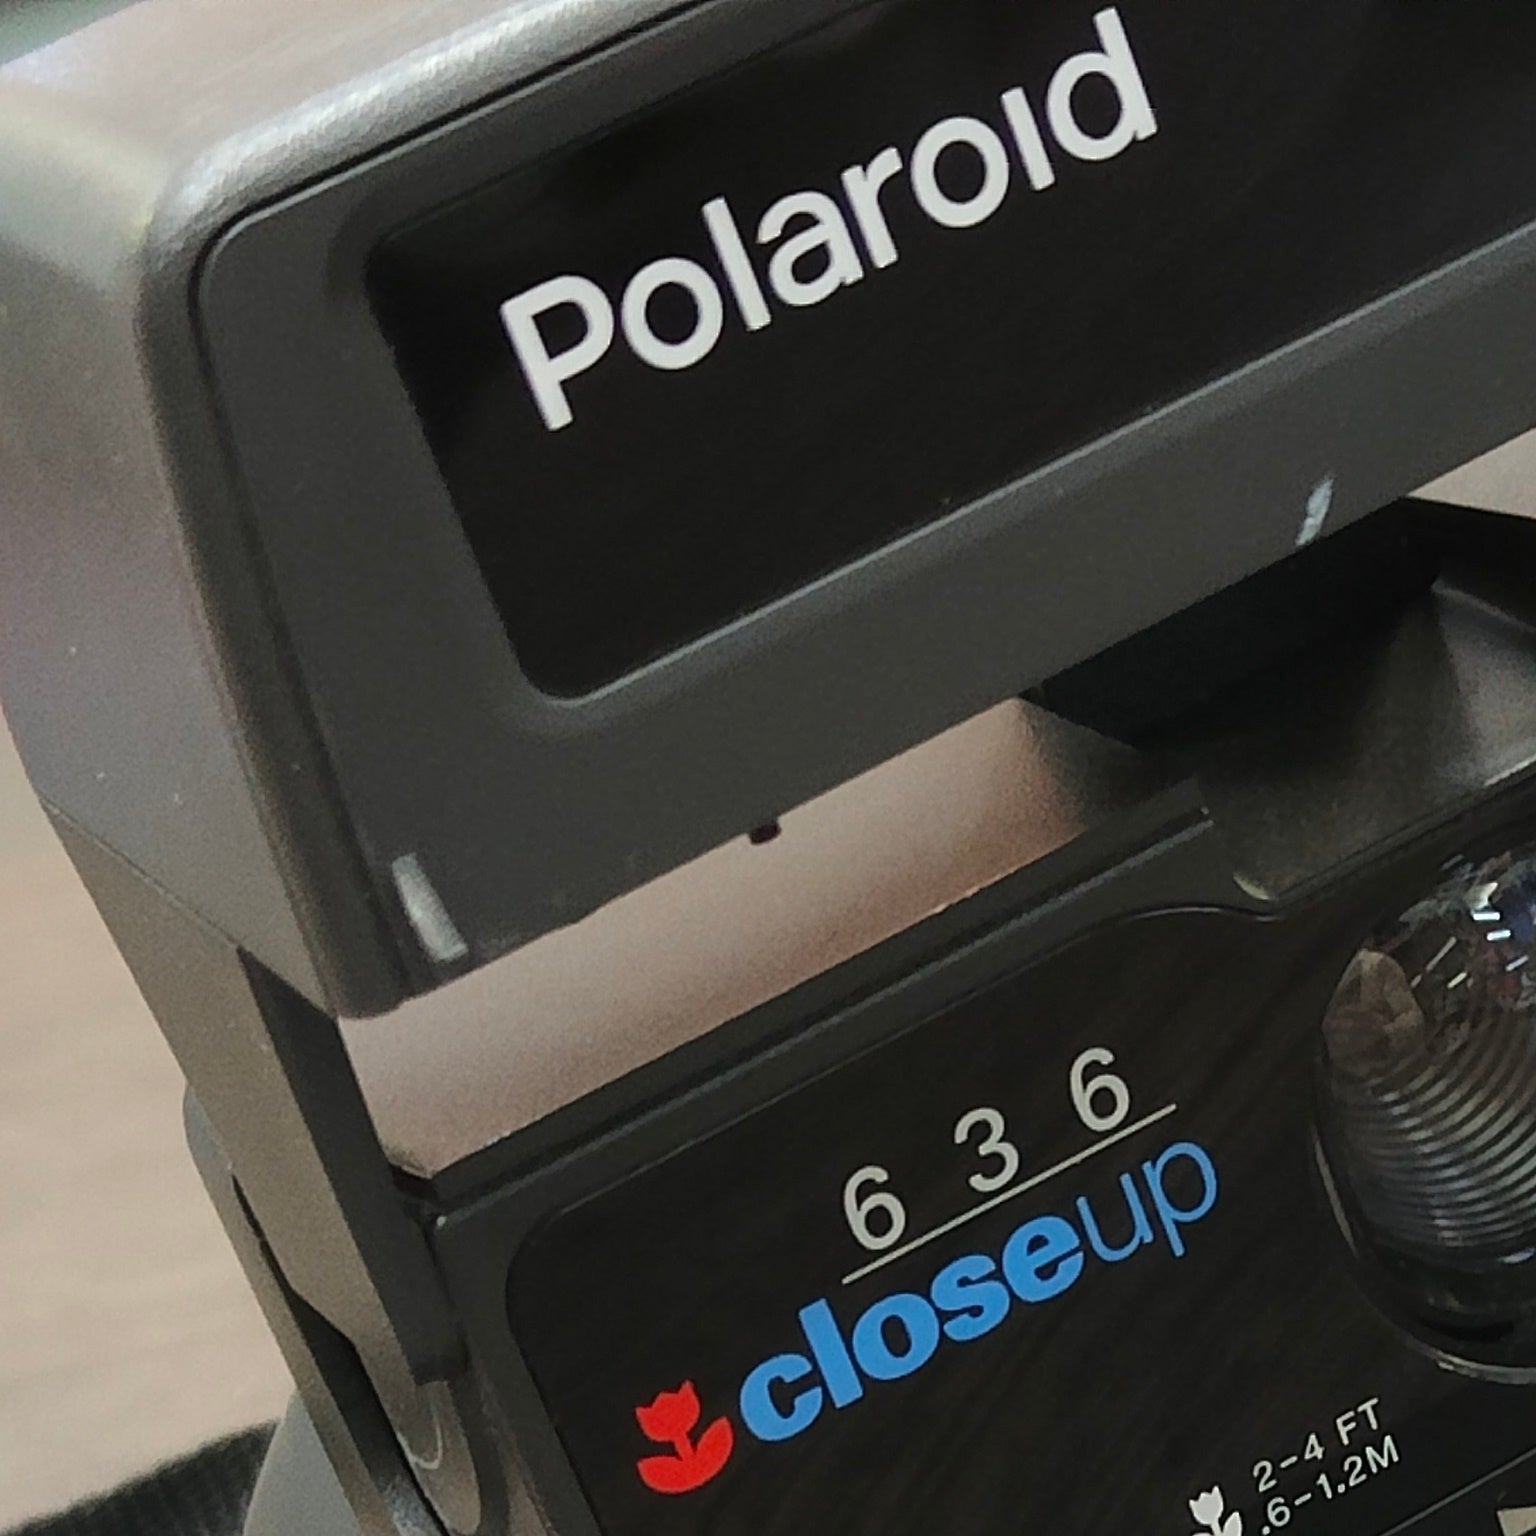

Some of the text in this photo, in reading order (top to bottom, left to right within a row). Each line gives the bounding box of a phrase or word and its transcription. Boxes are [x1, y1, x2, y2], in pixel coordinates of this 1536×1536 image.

[501, 7, 1158, 430] Polaroid
[739, 1142, 1219, 1442] closeup
[1252, 1397, 1379, 1493] 2-4 FT
[1262, 1434, 1399, 1536] .6-1.2M
